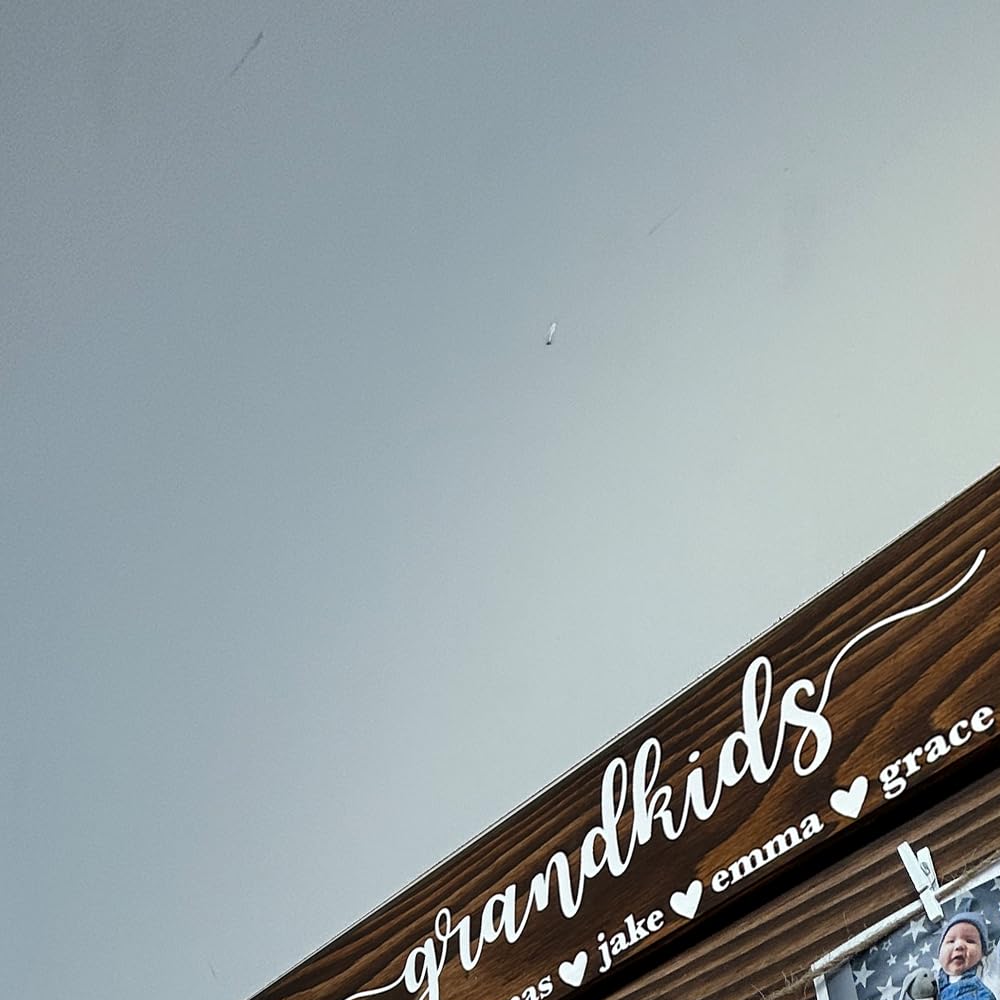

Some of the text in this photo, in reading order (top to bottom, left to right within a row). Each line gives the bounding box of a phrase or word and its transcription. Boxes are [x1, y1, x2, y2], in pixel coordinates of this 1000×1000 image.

[596, 909, 665, 974] jake
[710, 812, 825, 894] emma
[879, 705, 996, 801] grace
